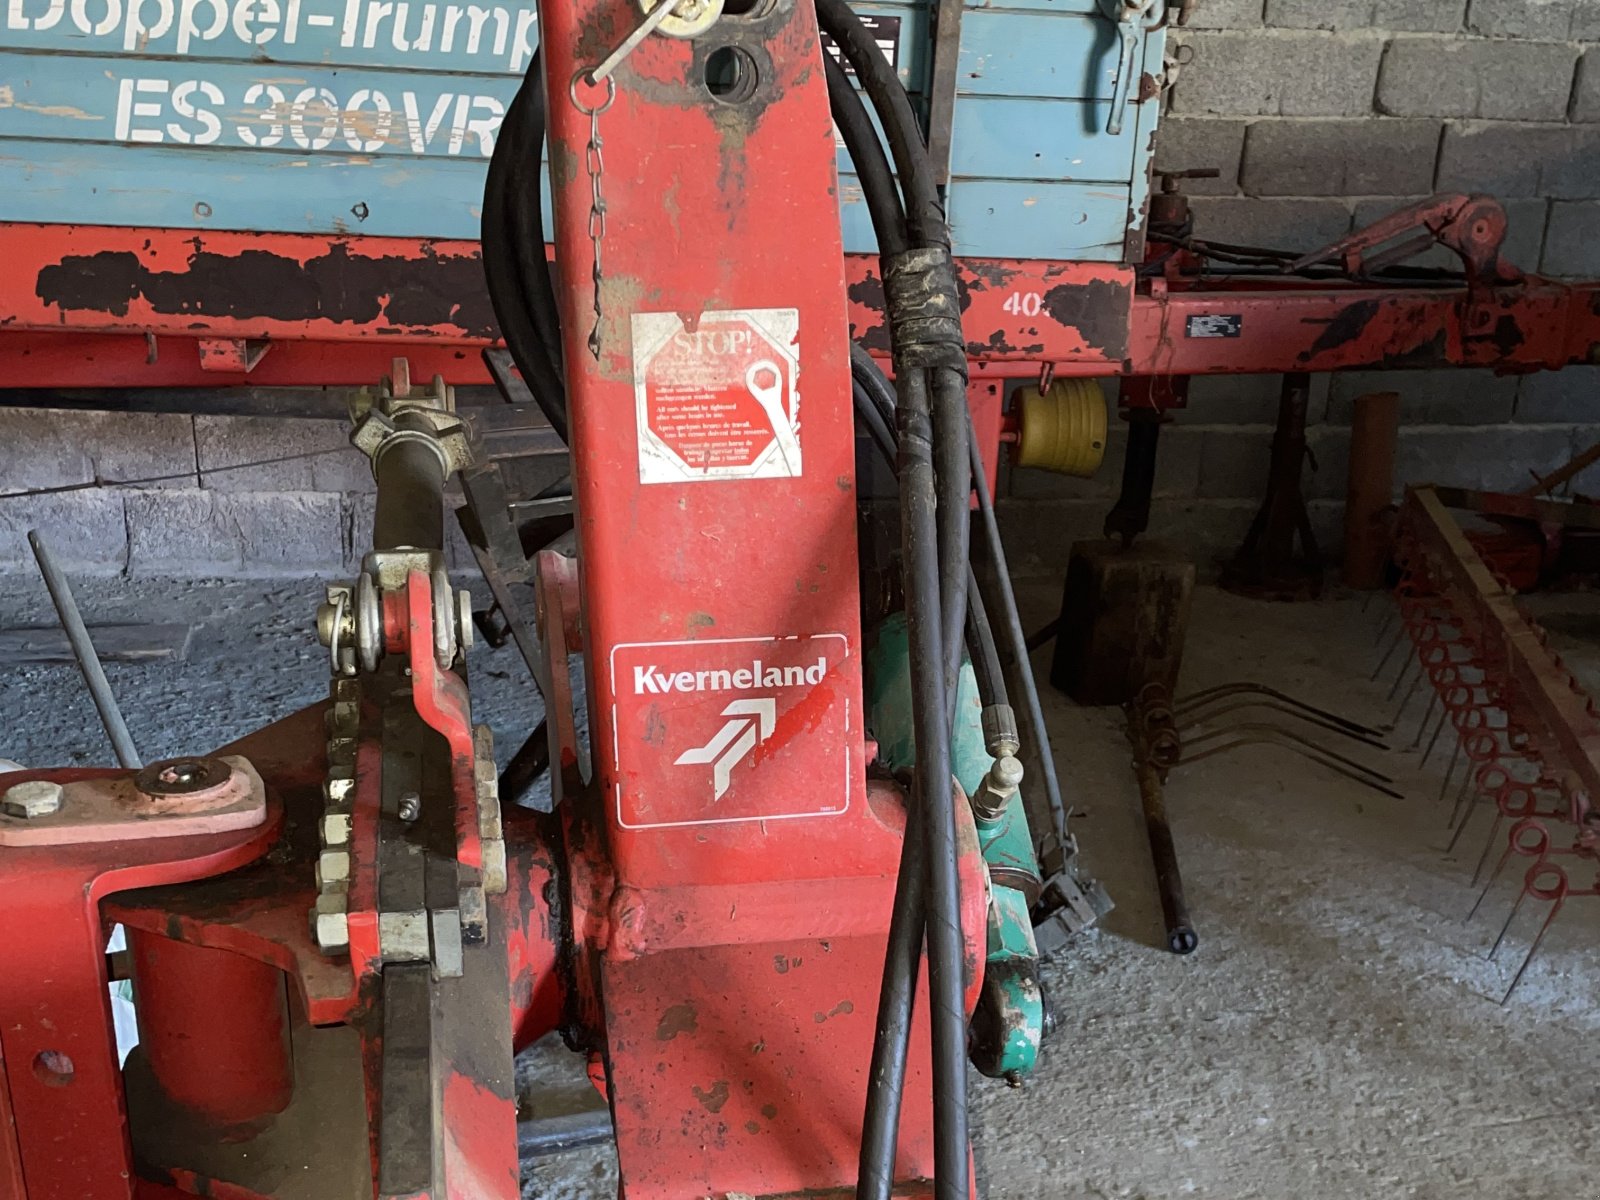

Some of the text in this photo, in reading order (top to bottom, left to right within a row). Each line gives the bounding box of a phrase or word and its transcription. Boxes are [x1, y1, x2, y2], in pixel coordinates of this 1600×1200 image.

[114, 78, 225, 144] ES
[674, 330, 752, 355] STOP!
[633, 657, 827, 694] Kverneland
